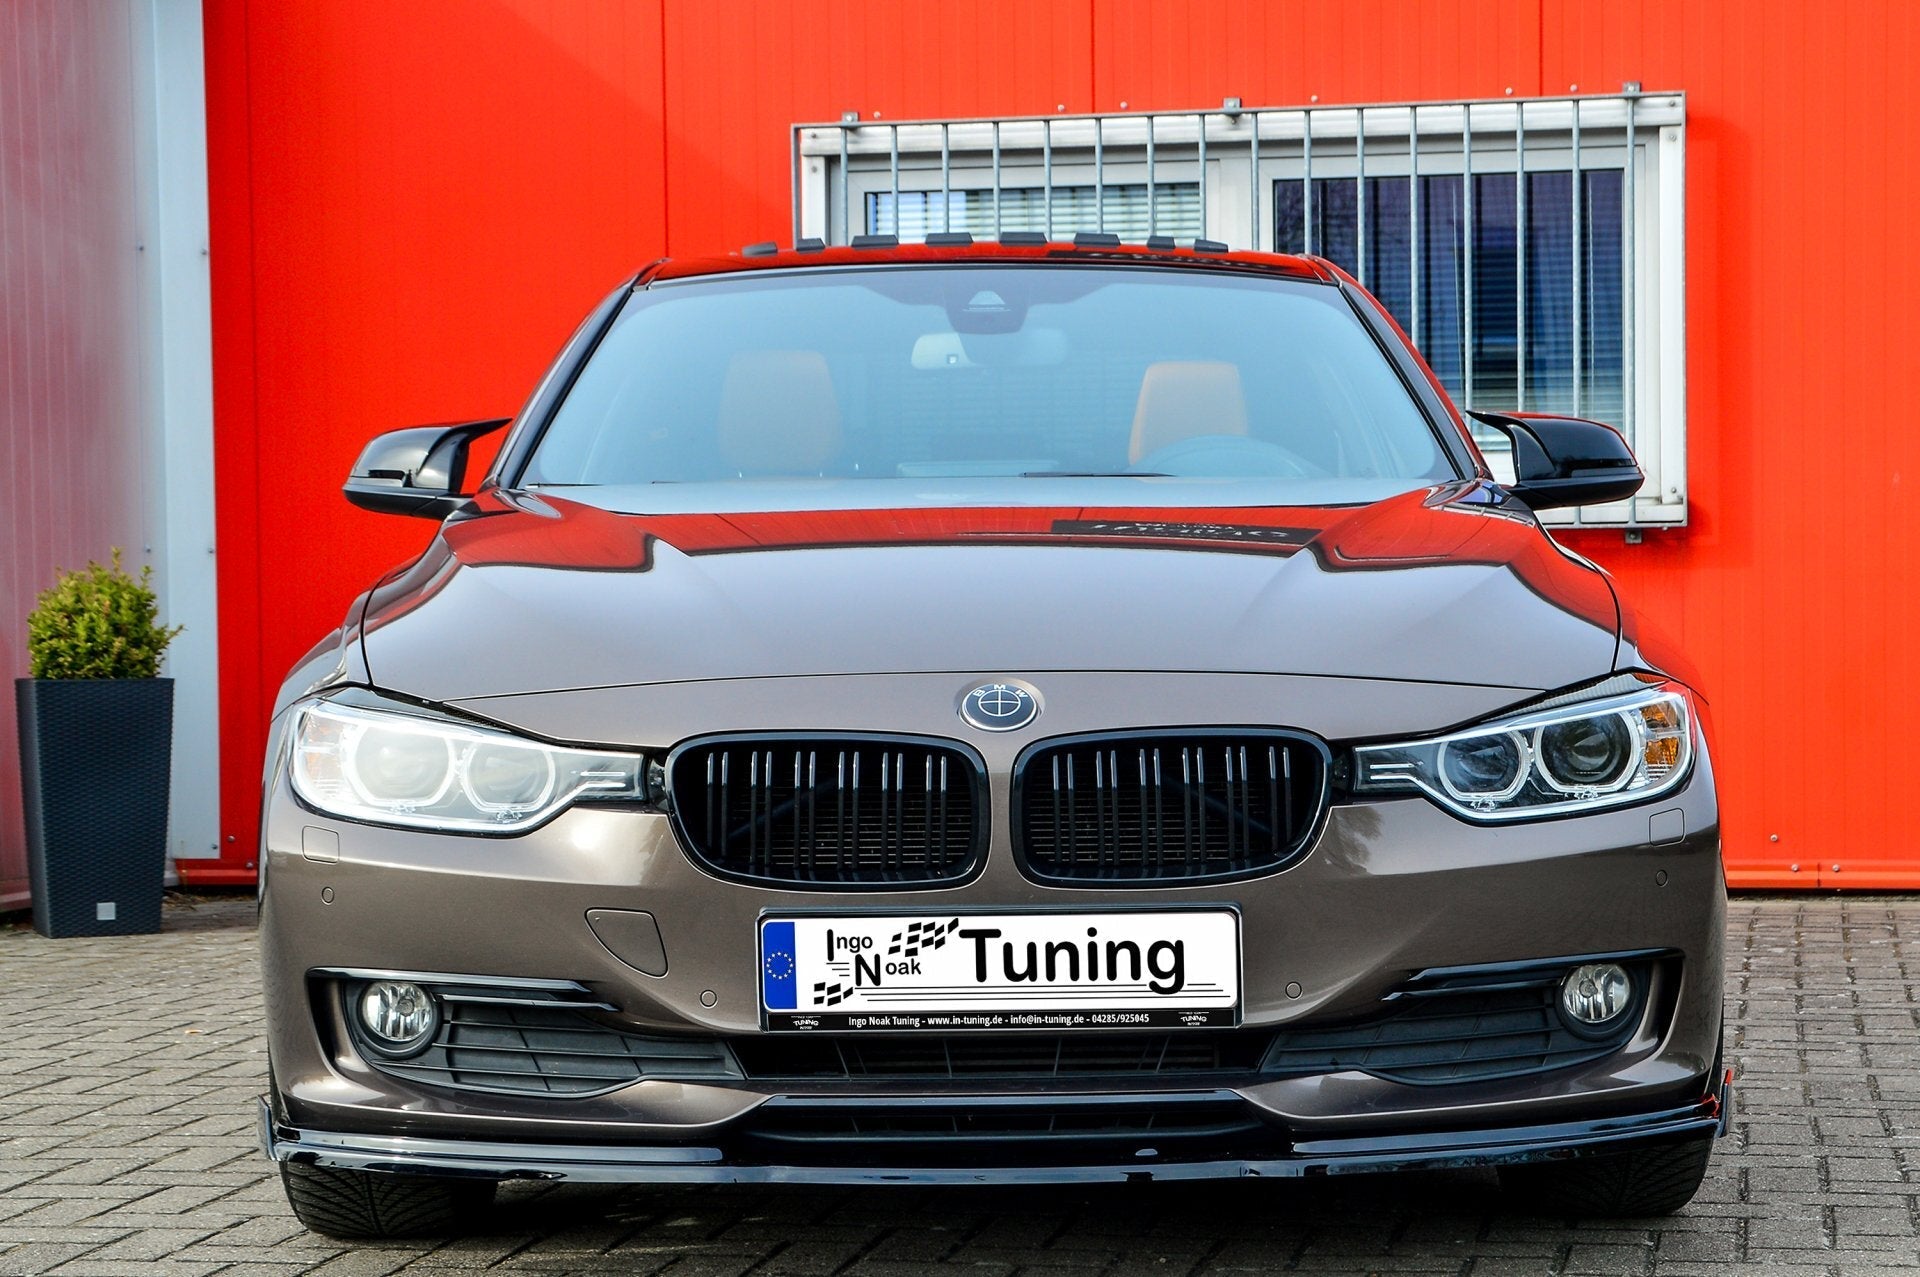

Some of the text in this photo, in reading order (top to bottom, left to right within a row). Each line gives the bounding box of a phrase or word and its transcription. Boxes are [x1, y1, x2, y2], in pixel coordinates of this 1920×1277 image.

[973, 684, 1028, 698] BMW
[826, 928, 873, 961] Ingo
[958, 927, 1185, 995] Tuning
[854, 953, 922, 987] Noak
[848, 1016, 867, 1027] Ingo
[869, 1016, 891, 1026] Noak
[893, 1016, 920, 1027] Tuning
[927, 1015, 1003, 1027] www.in-tuning.de
[1010, 1014, 1084, 1026] info@in-tuning.de
[1092, 1013, 1150, 1024] 04285/925045
